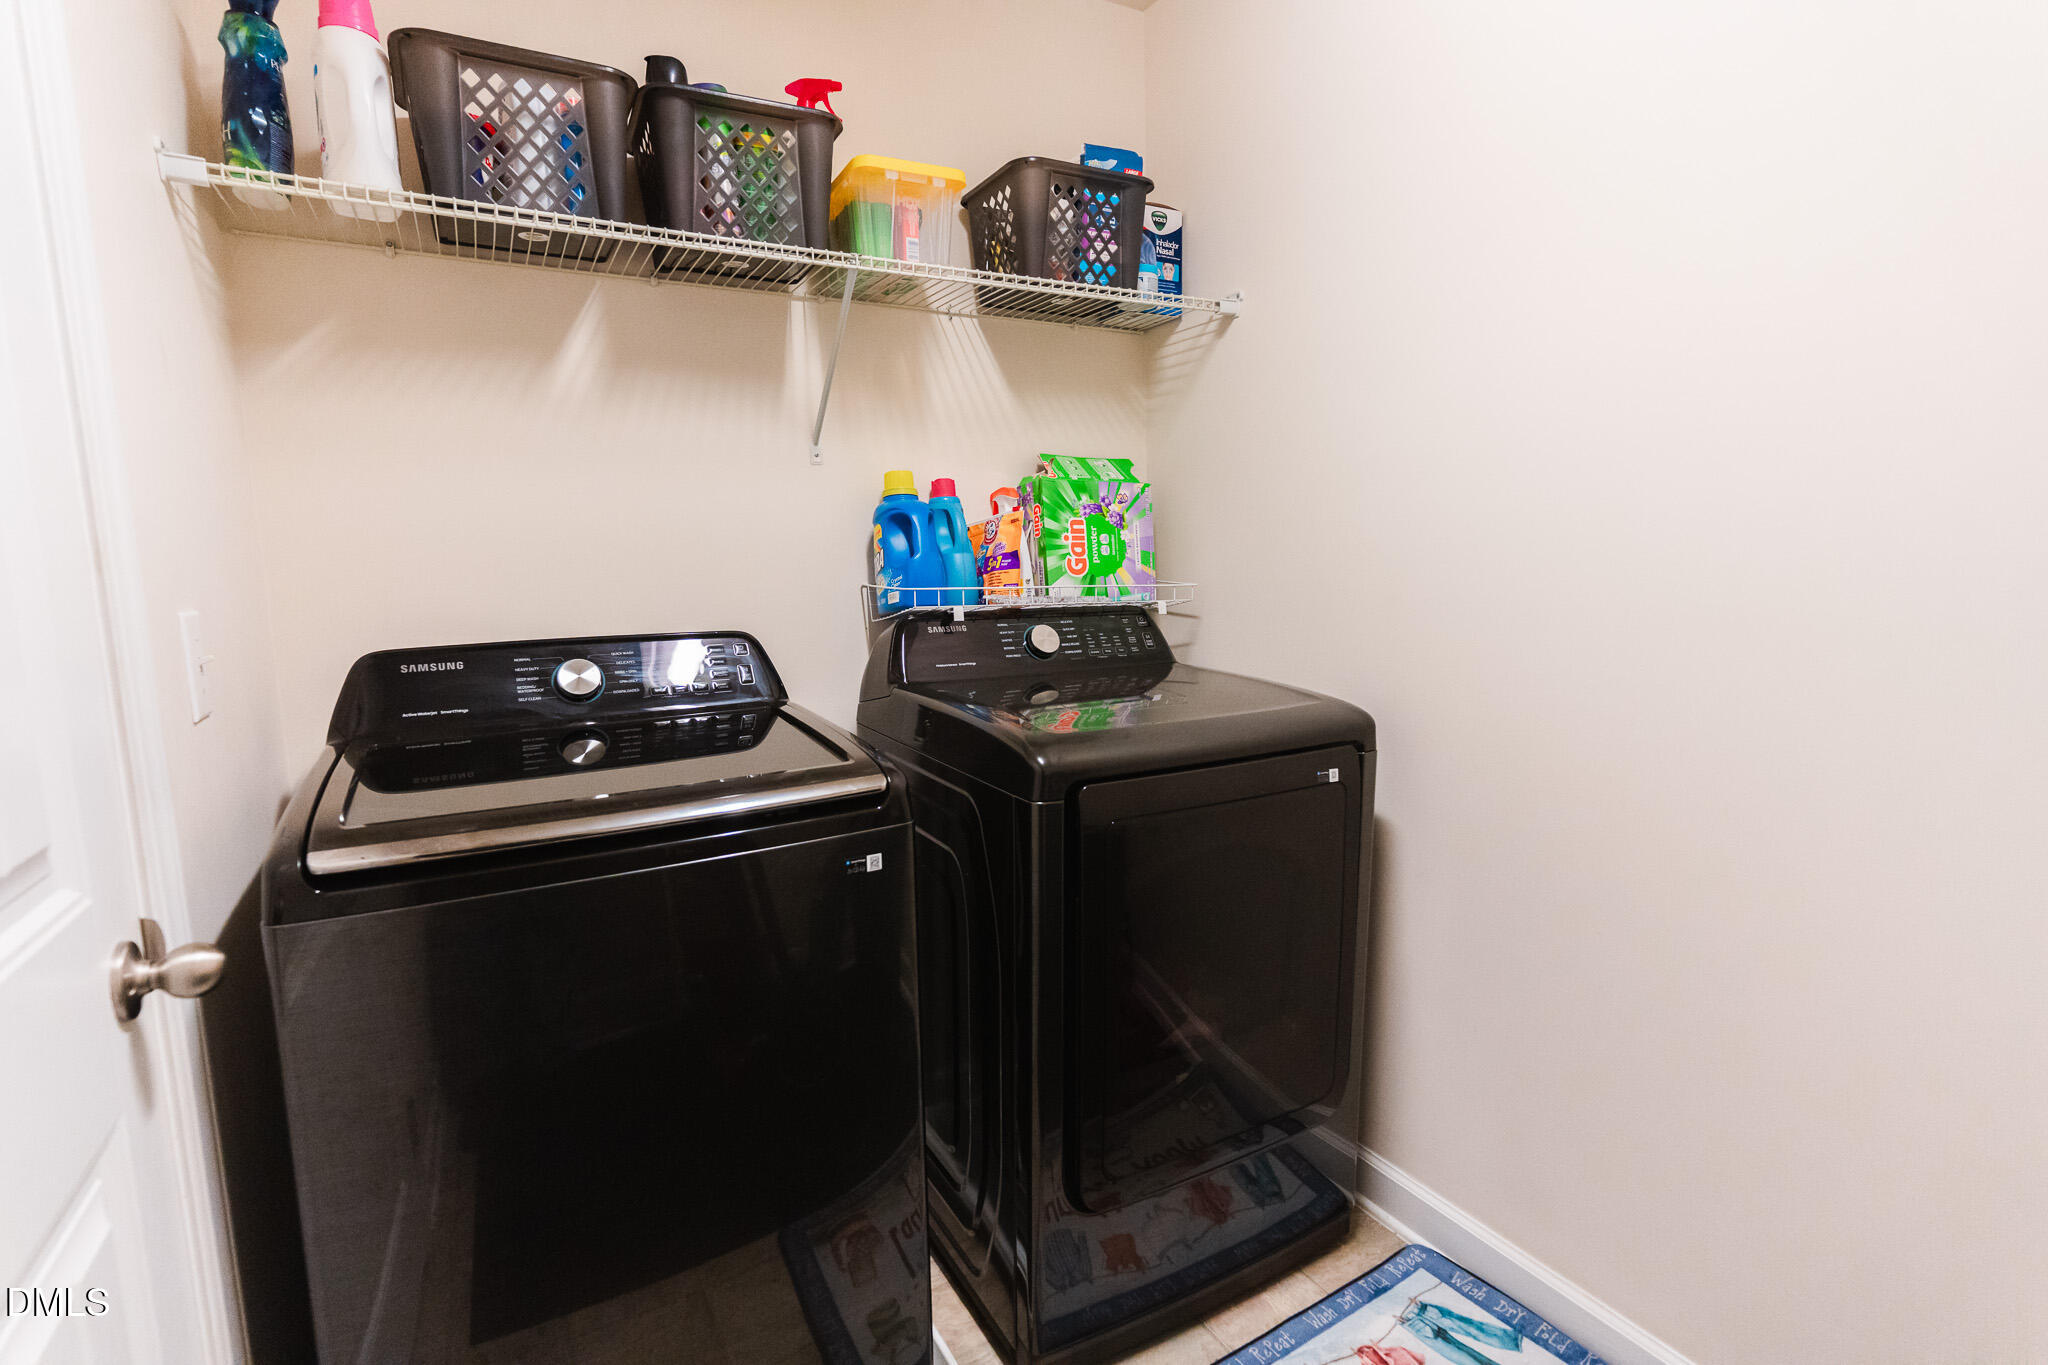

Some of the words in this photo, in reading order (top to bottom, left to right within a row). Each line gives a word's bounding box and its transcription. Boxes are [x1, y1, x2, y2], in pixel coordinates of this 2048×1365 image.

[1156, 238, 1179, 249] Inhalador
[1156, 246, 1174, 256] Nasal
[1034, 505, 1043, 537] Gain
[1063, 519, 1088, 576] Gain
[1091, 525, 1100, 563] powder
[928, 625, 967, 633] SAMSUNG
[400, 661, 464, 673] SAMSUNG
[1450, 1271, 1486, 1302] Wash
[1302, 1305, 1338, 1329] Wash
